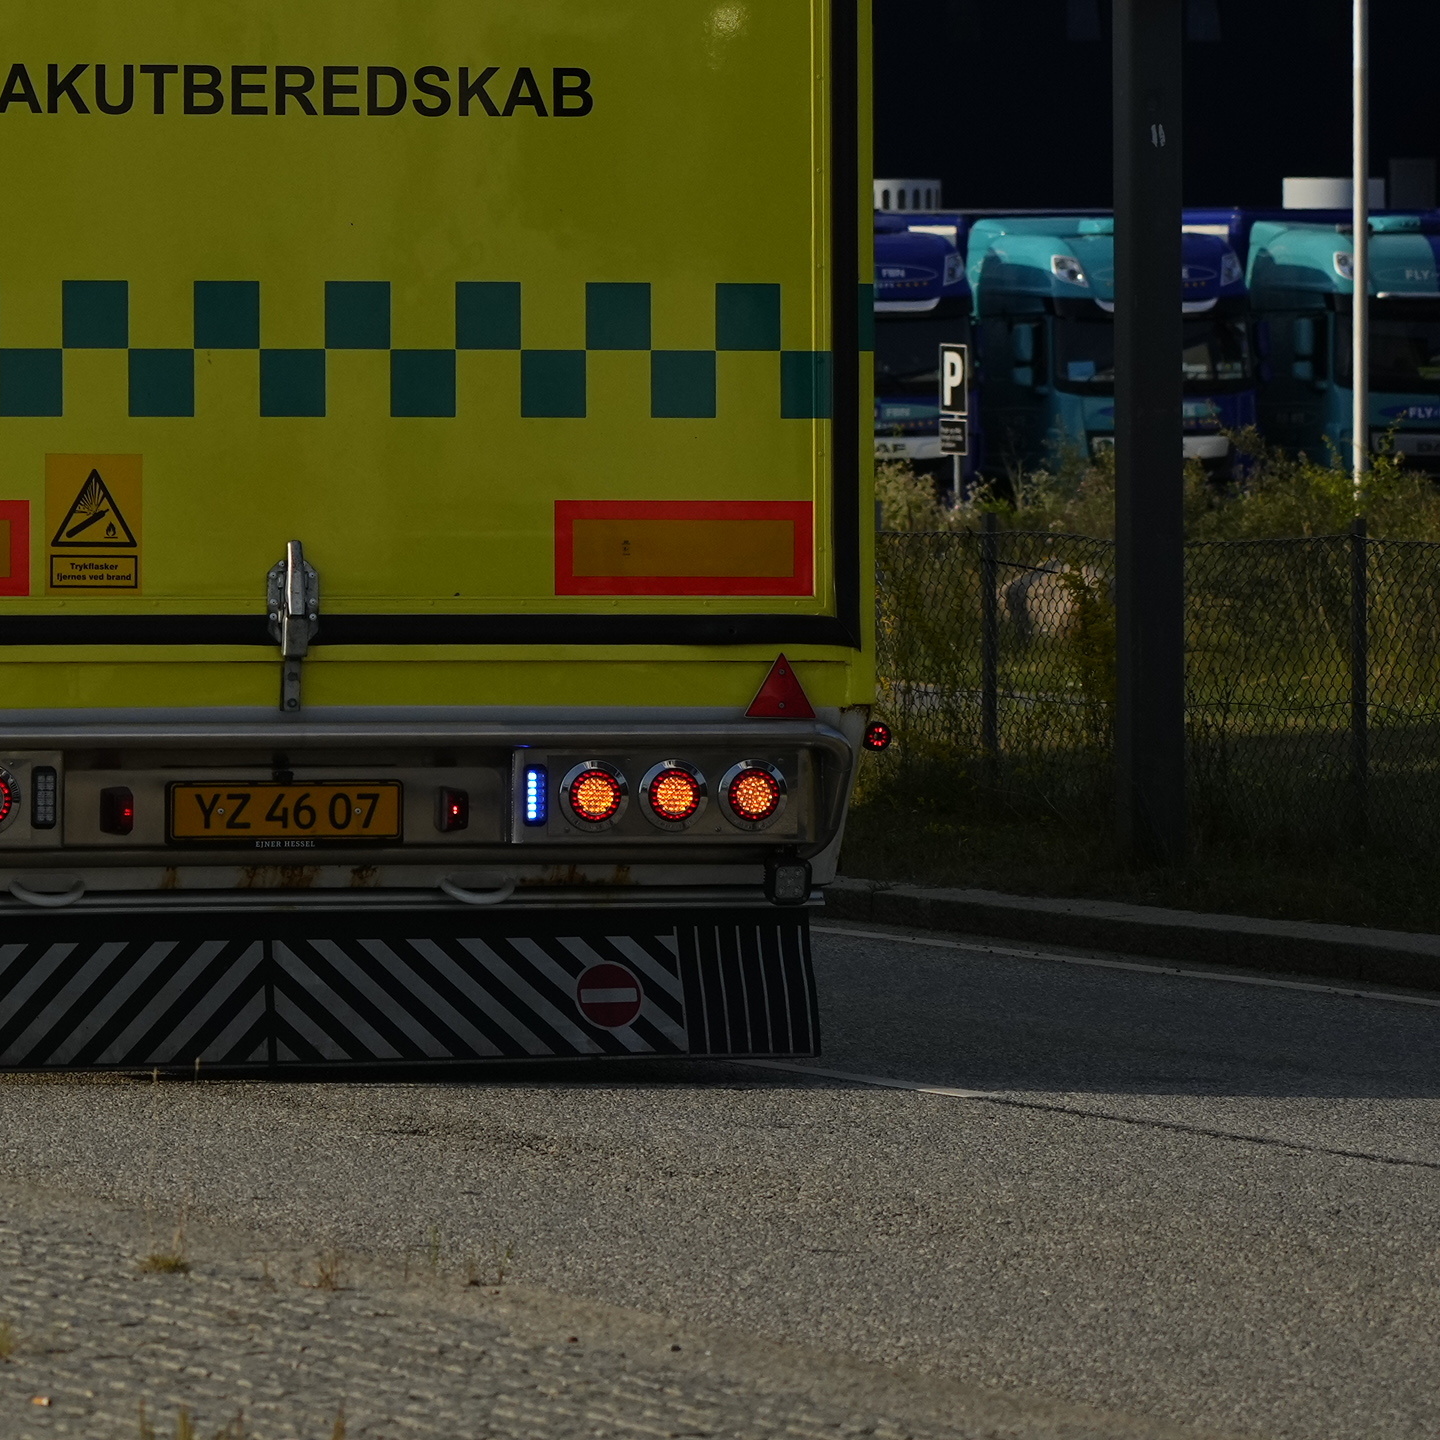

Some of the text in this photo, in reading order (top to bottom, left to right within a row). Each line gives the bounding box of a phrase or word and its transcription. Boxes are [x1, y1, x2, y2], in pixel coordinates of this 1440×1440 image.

[943, 351, 963, 406] P
[876, 443, 905, 453] AF
[70, 562, 118, 571] Trykflasker
[57, 573, 87, 581] fjernes
[106, 573, 131, 581] brand
[194, 792, 380, 830] YZ 46 07
[255, 840, 316, 849] EJNER HESSEL
